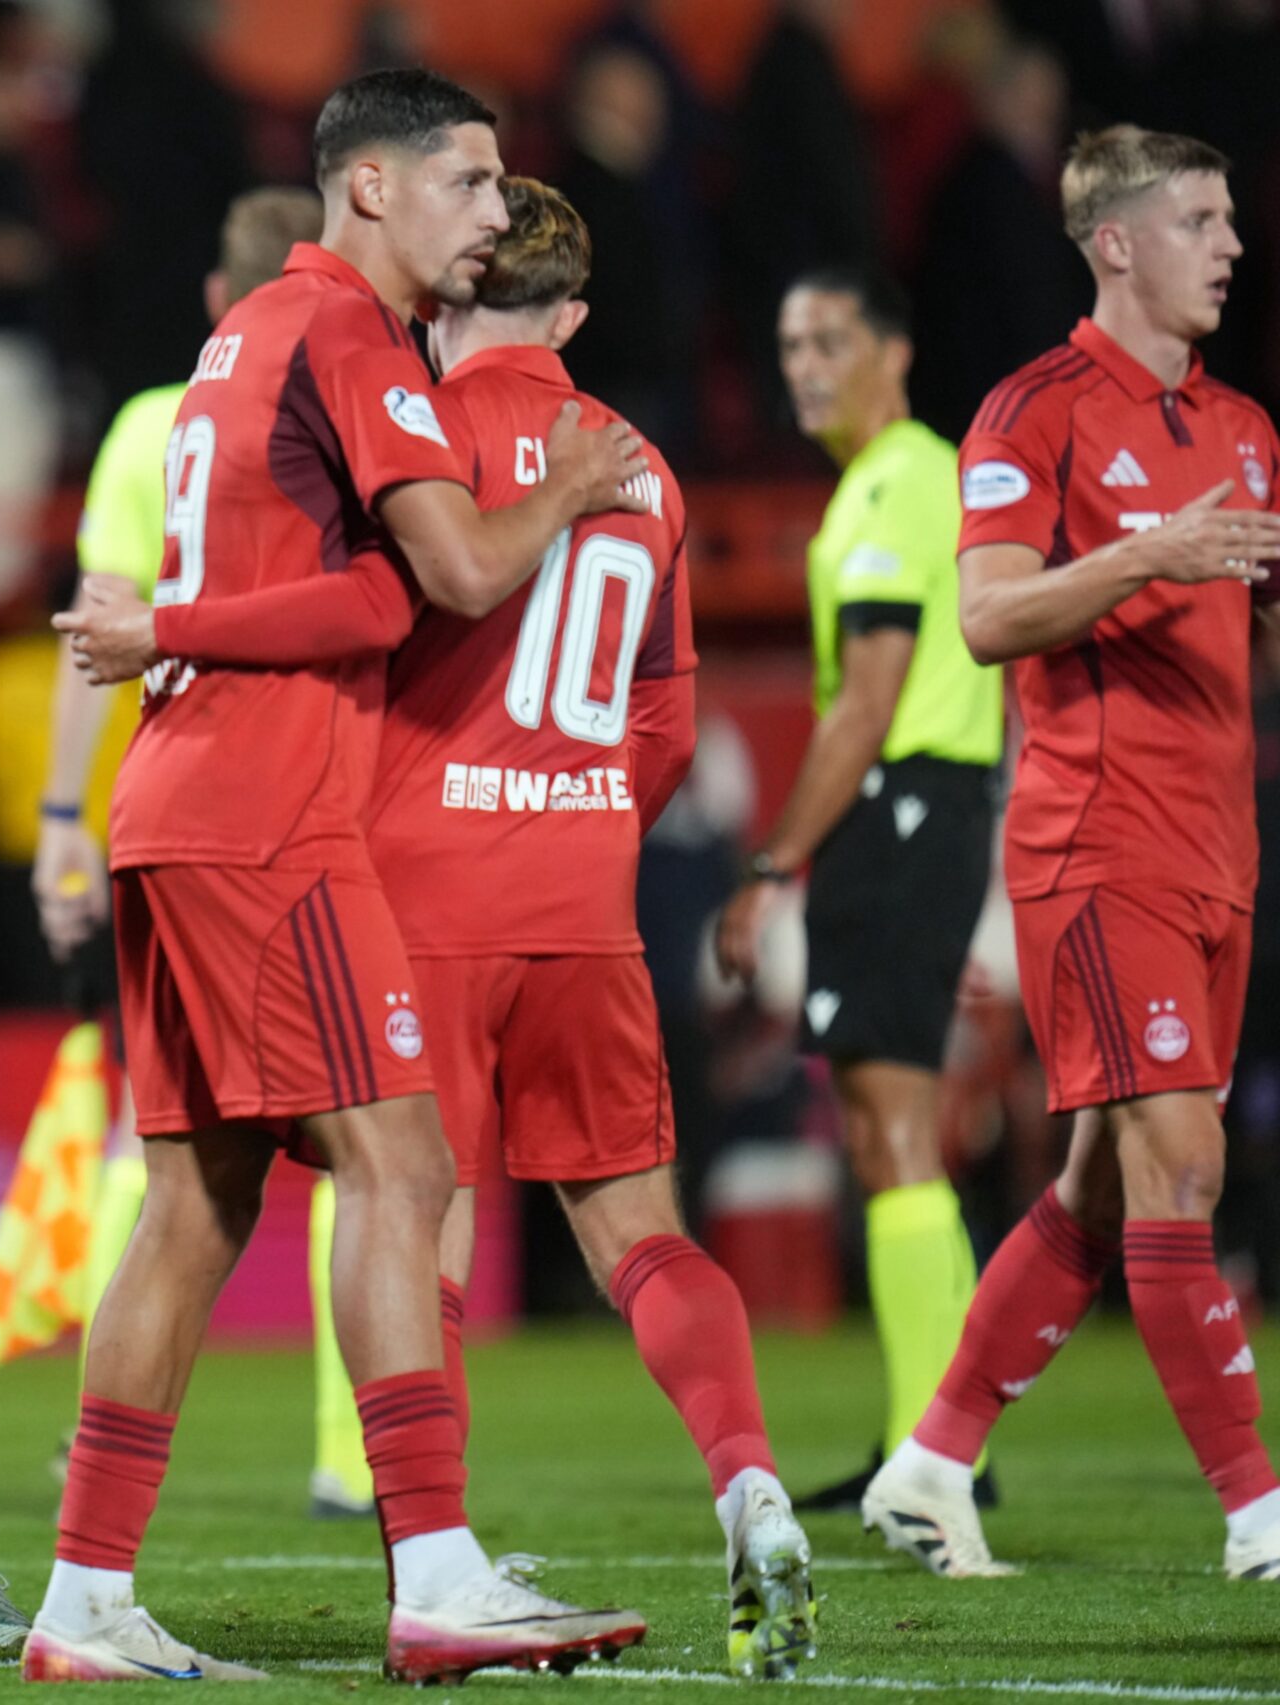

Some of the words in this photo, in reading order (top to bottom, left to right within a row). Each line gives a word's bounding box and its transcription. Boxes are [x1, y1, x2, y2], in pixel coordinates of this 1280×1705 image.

[505, 525, 656, 747] 10
[443, 767, 501, 811] EIS
[505, 767, 632, 812] WASTE
